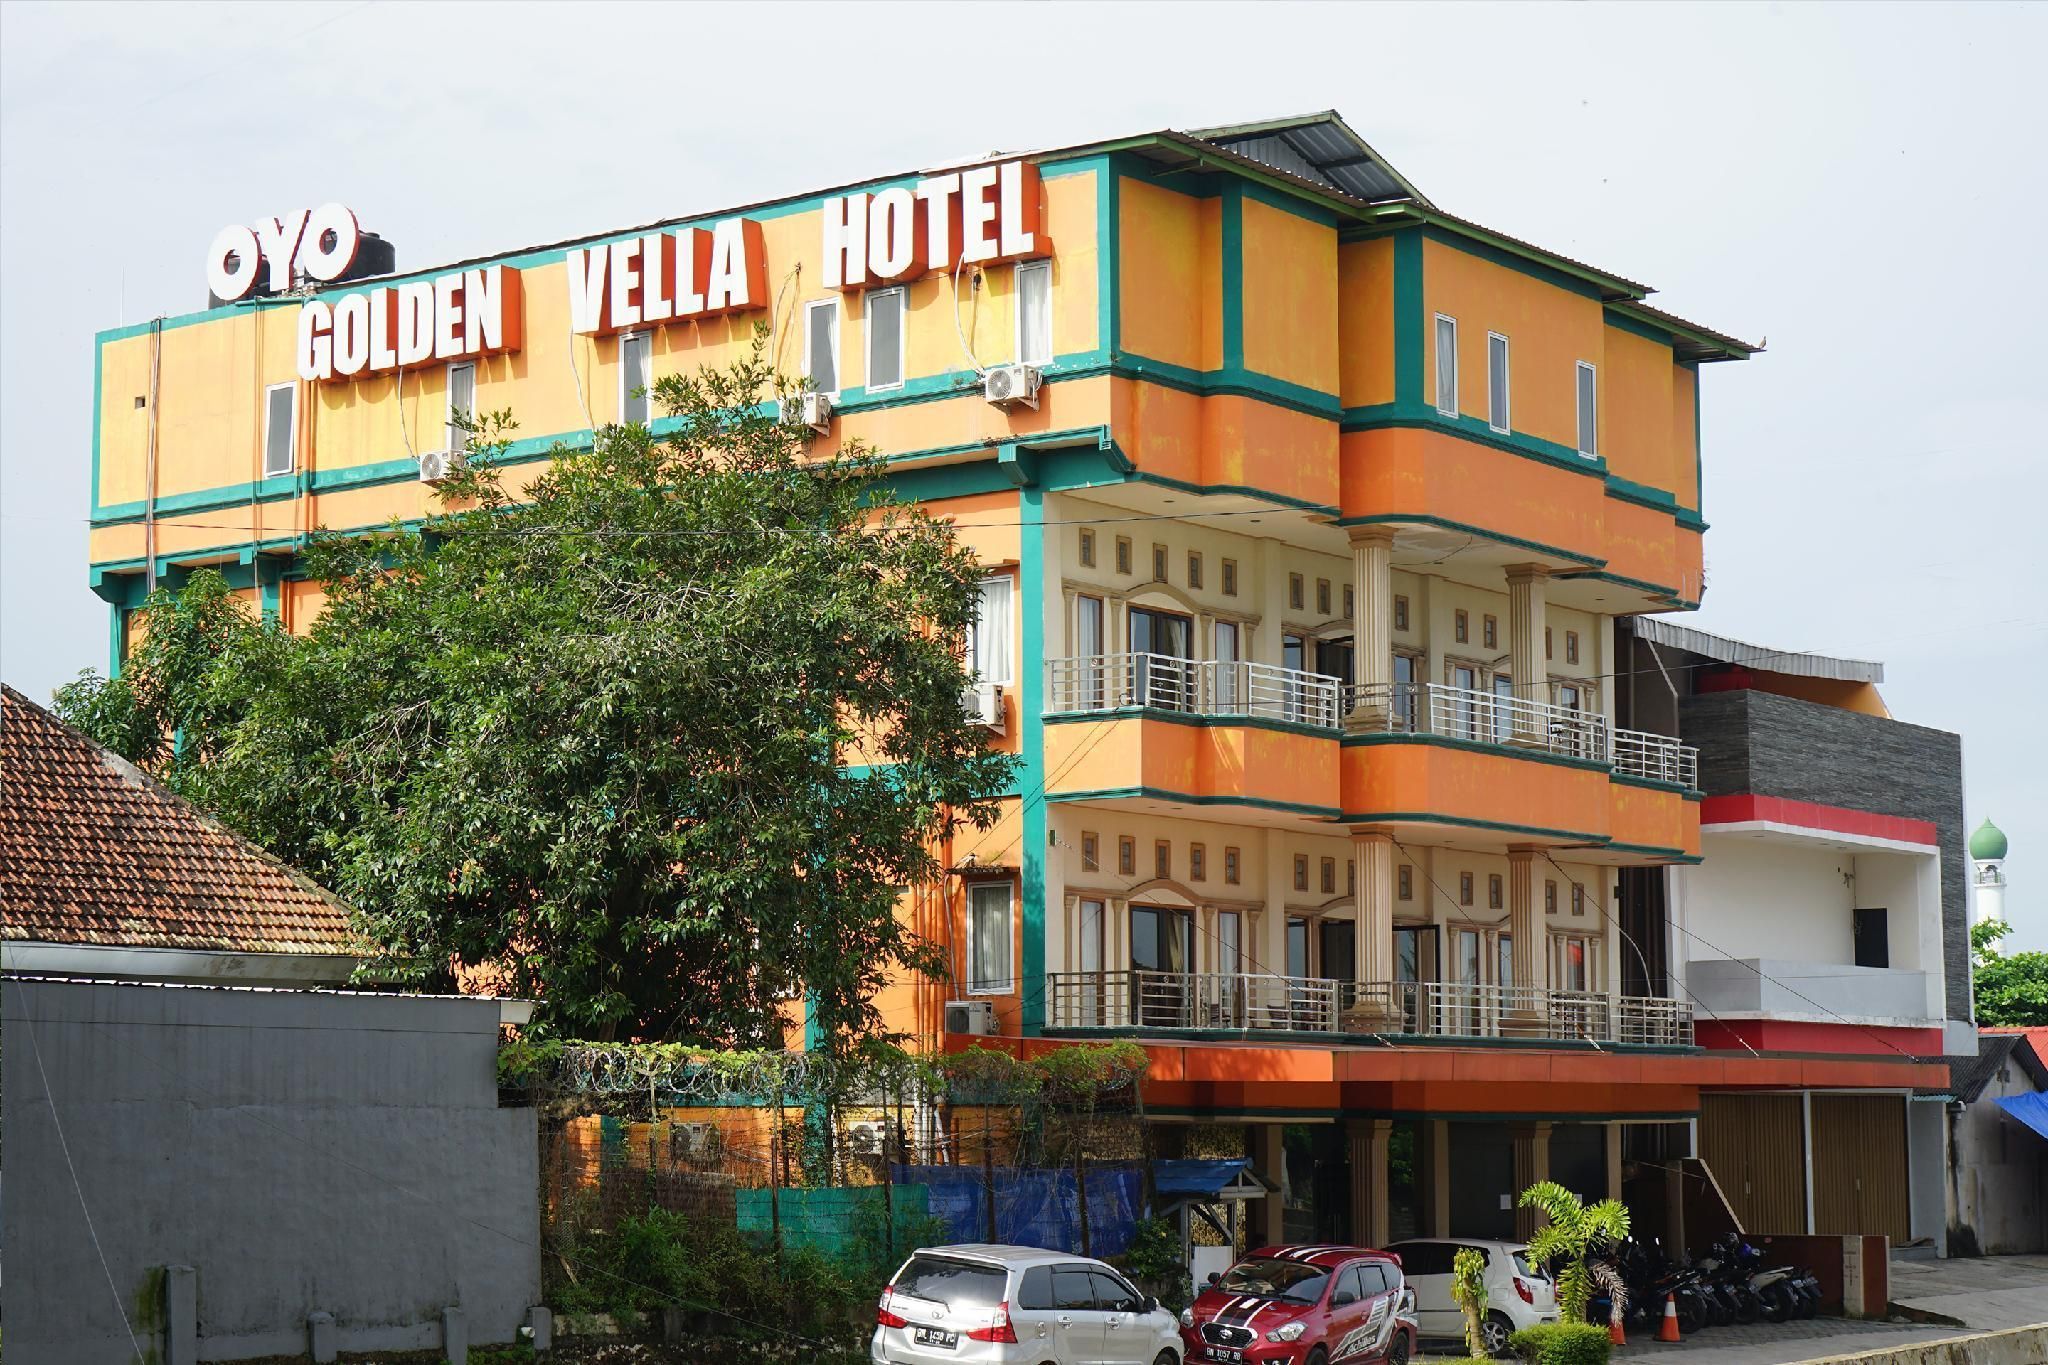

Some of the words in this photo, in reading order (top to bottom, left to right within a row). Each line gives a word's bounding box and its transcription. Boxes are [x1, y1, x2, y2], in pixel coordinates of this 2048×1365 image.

[207, 202, 357, 301] OYO
[298, 264, 503, 381] GOLDEN
[566, 217, 750, 334] VELLA
[822, 160, 1035, 289] HOTEL
